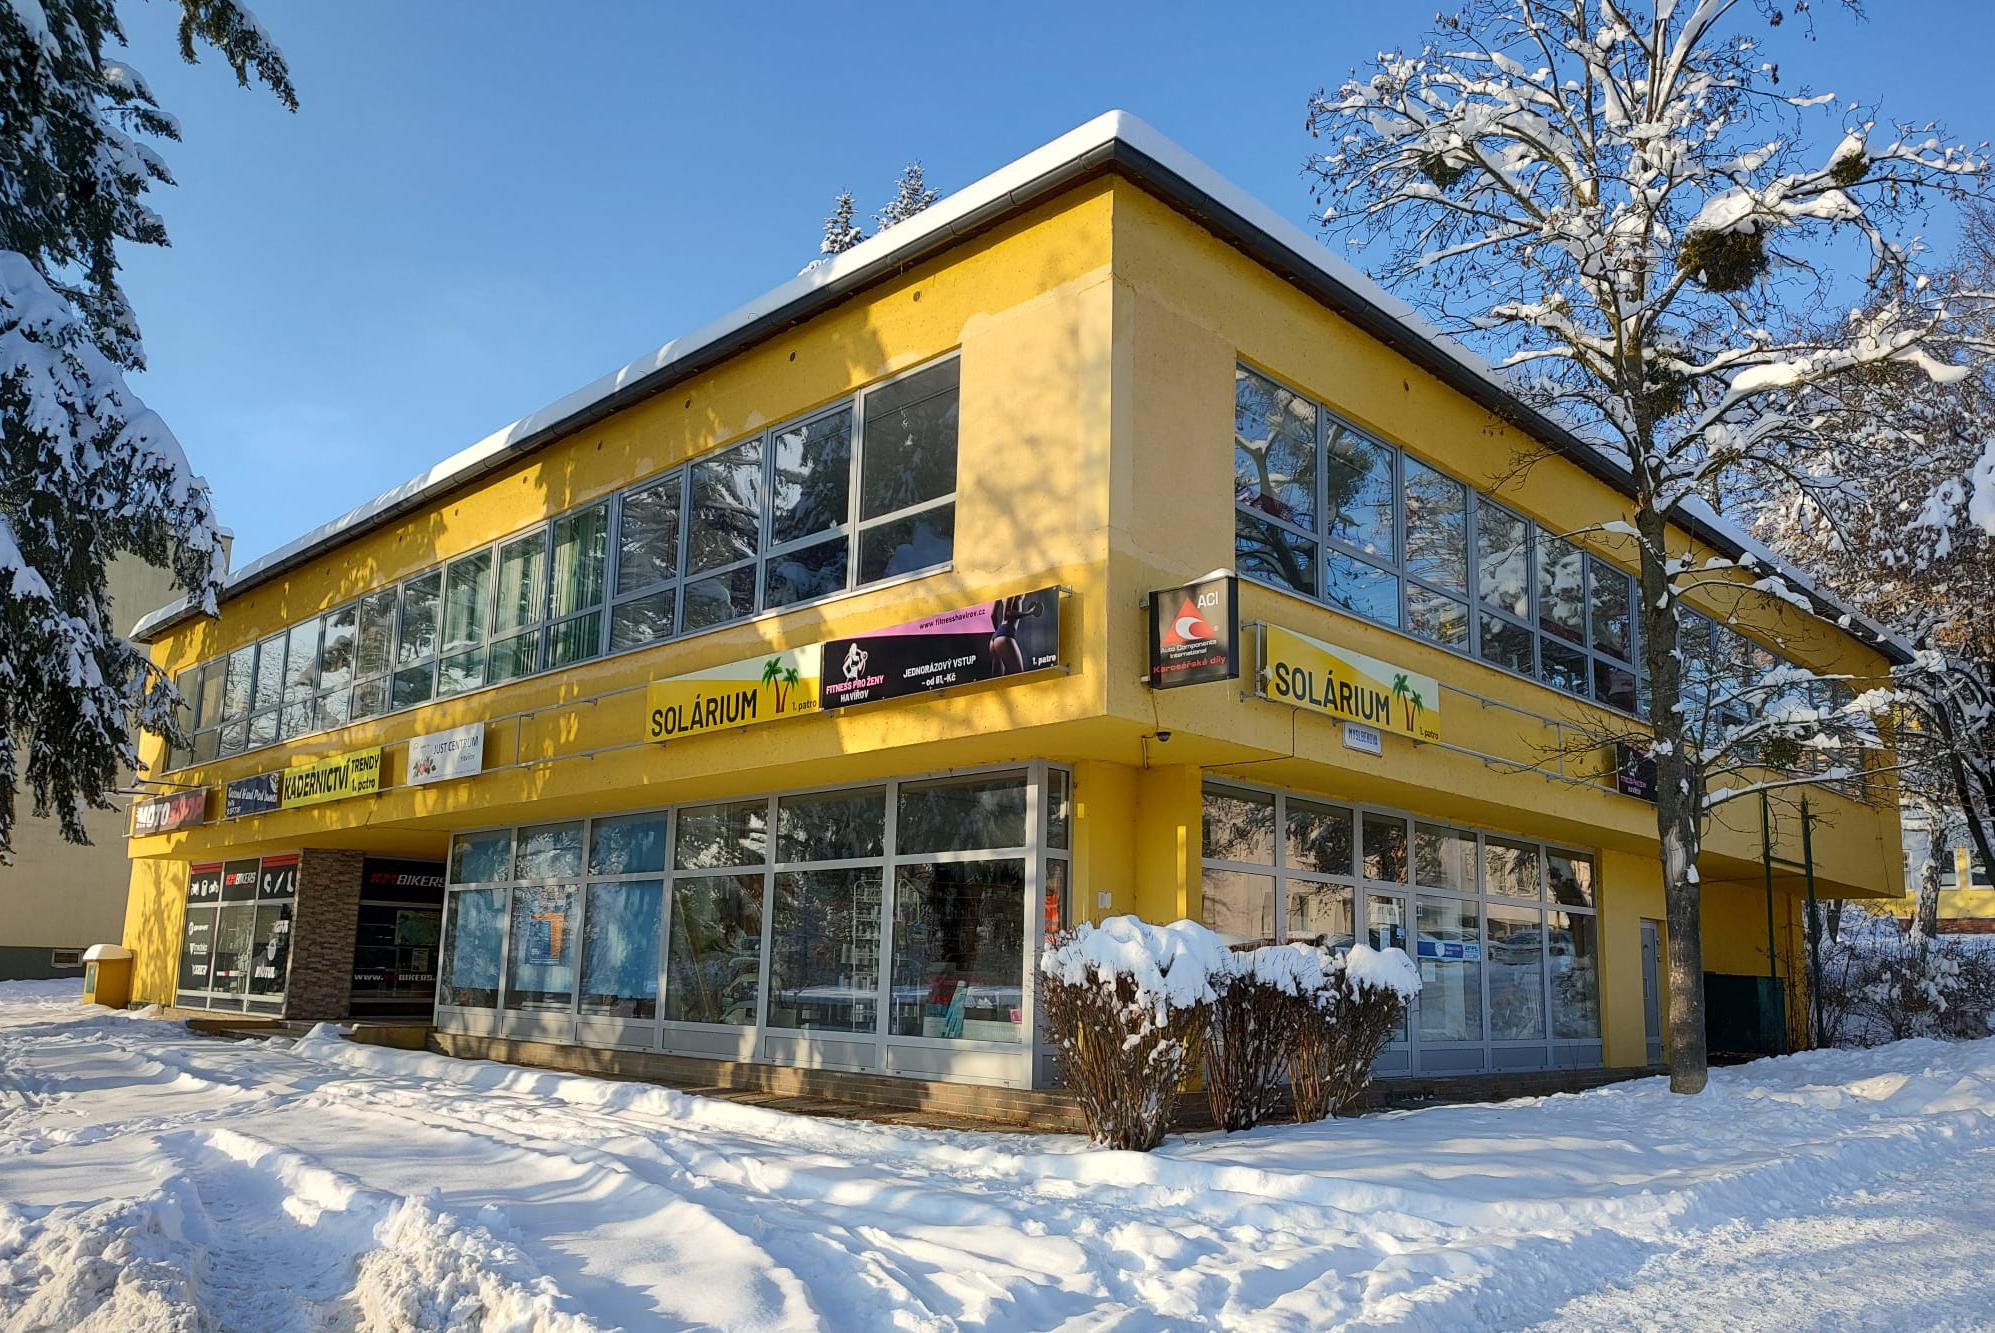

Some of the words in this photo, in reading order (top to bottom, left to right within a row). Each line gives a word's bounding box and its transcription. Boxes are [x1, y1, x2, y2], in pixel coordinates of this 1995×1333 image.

[1197, 591, 1219, 609] ACI
[1038, 653, 1057, 667] patro
[1169, 647, 1208, 659] International
[903, 657, 952, 679] JEDNORÁZOVÝ
[952, 654, 977, 668] VSTUP
[826, 680, 852, 695] FITNESS
[852, 678, 867, 690] PRO
[866, 674, 885, 687] ŽENY
[1274, 662, 1390, 725] SOLÁRIUM
[798, 699, 817, 712] patro
[840, 689, 869, 703] HAVÍŘOV
[651, 688, 758, 737] SOLÁRIUM
[1424, 729, 1439, 740] patro
[433, 742, 448, 755] JUST
[448, 735, 479, 752] CENTRUM
[351, 753, 380, 774] TRENDY
[283, 757, 350, 801] KADEŘNICTVÍ
[357, 776, 376, 793] patro
